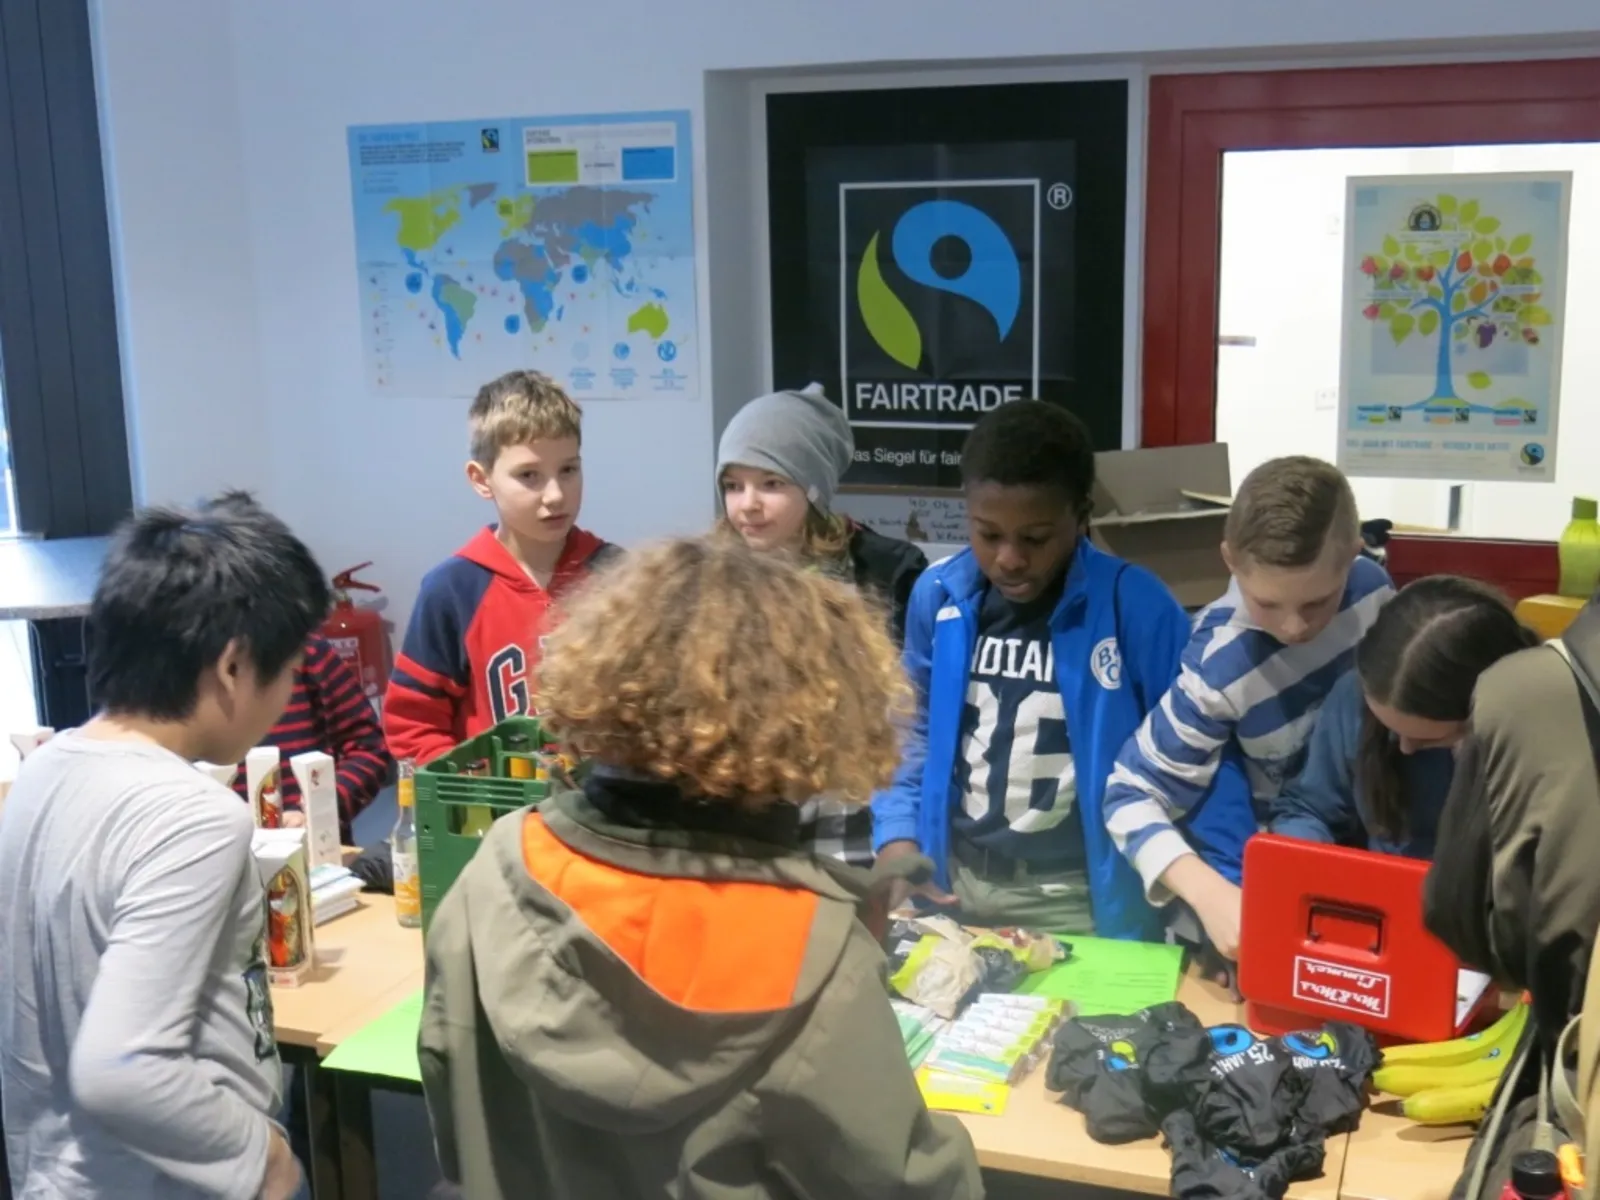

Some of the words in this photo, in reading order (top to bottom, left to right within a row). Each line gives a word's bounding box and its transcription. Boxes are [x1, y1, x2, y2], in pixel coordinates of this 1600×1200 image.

[855, 383, 1023, 412] FAIRTRADE
[853, 450, 870, 462] as
[873, 448, 917, 467] Siegel
[919, 450, 937, 465] für
[1246, 1041, 1275, 1066] 25
